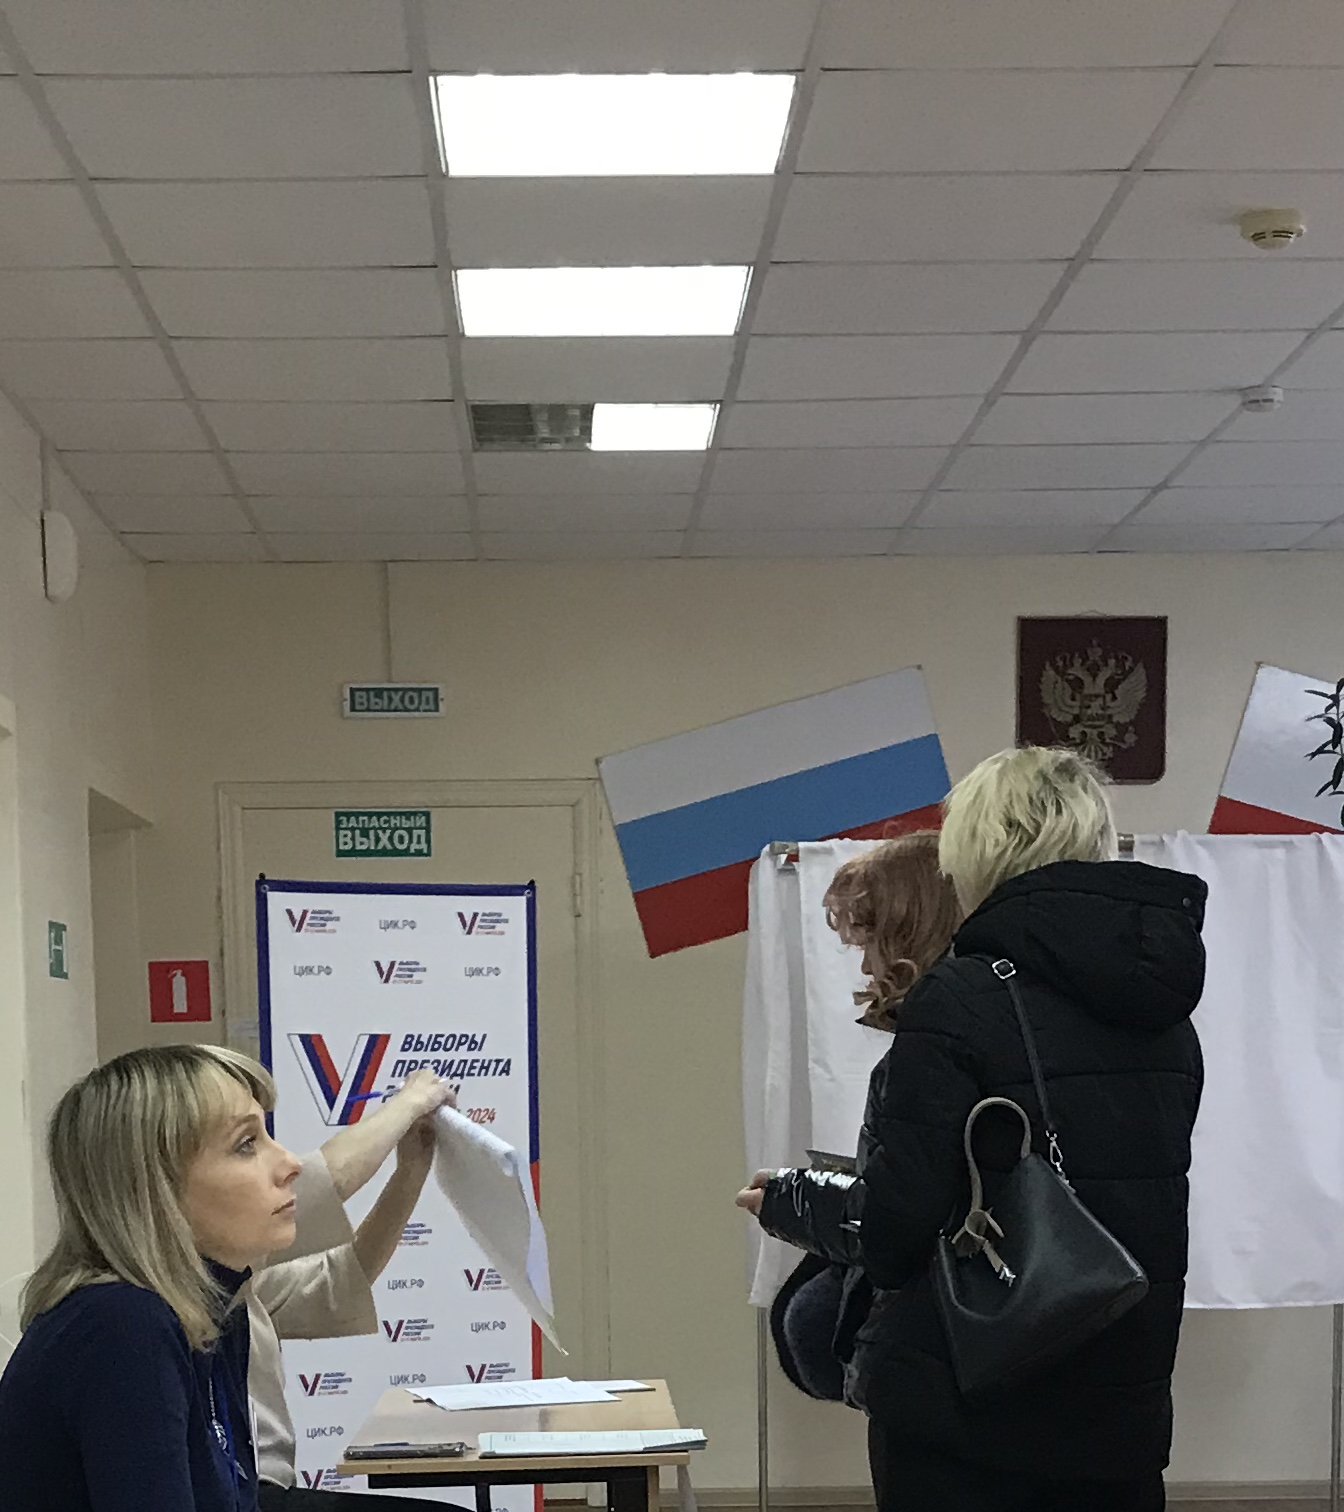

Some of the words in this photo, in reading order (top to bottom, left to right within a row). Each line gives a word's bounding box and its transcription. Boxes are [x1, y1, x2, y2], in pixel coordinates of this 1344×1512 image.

[354, 691, 435, 711] ВЫХОД
[338, 813, 426, 829] ЗАПАСНЫЙ
[338, 829, 428, 854] ВЫХОД
[379, 918, 417, 931] ЦИК.РФ
[293, 964, 333, 977] ЦИК.РФ
[464, 966, 501, 978] ЦИК.РФ
[399, 1033, 488, 1053] ВЫБОРЫ
[390, 1058, 512, 1080] ПРЕЗИДЕНТА
[387, 1278, 425, 1291] ЦИК.РФ
[470, 1320, 507, 1334] ЦИК.РФ
[389, 1373, 427, 1387] ЦИК.РФ
[306, 1425, 345, 1439] ЦИК.РФ
